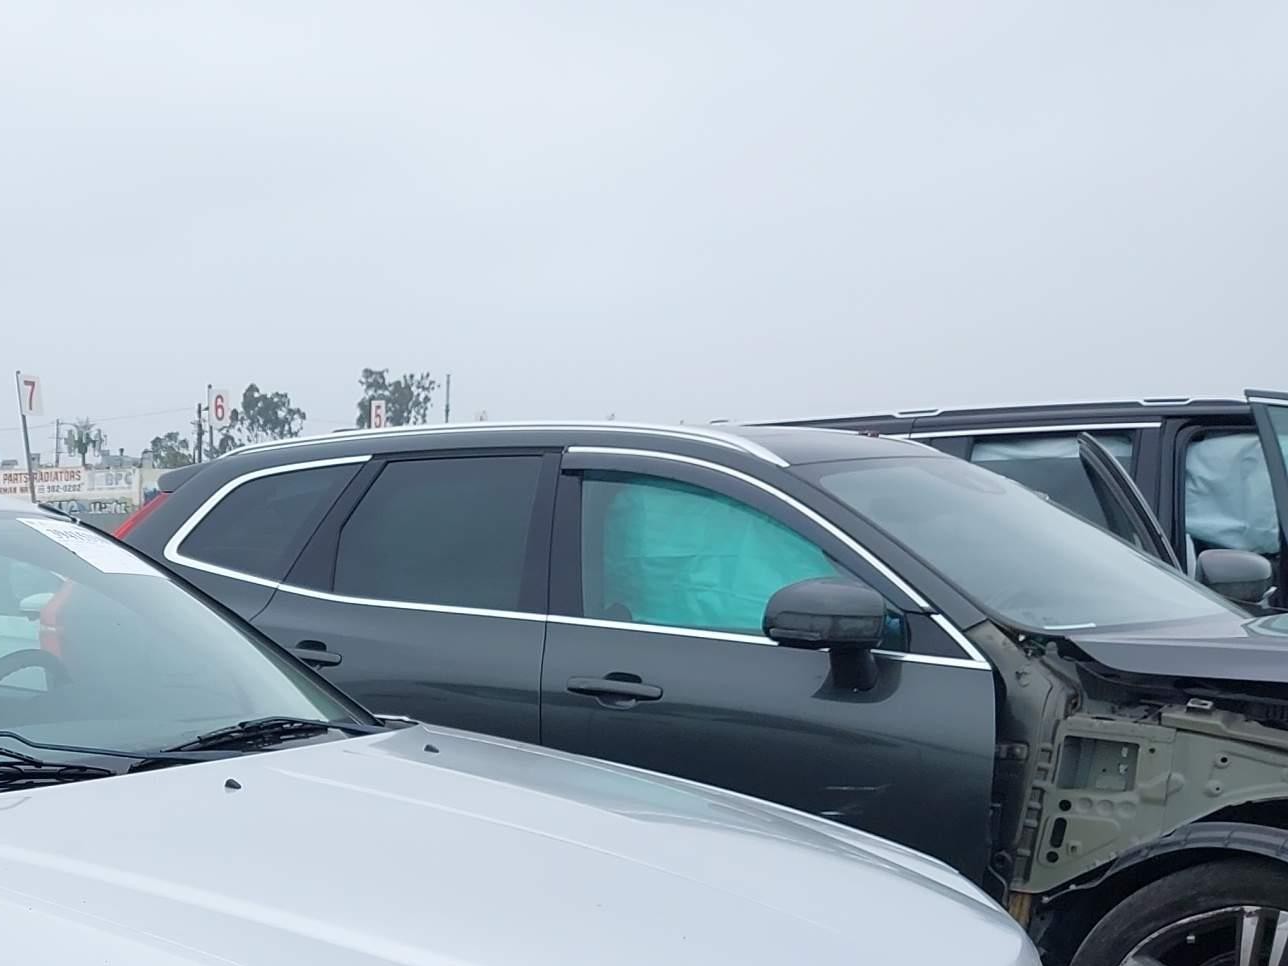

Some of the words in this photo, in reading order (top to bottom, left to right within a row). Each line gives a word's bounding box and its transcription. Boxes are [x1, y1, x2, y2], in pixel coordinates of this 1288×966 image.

[24, 380, 35, 411] 7
[215, 394, 225, 421] 6
[375, 405, 382, 428] 5
